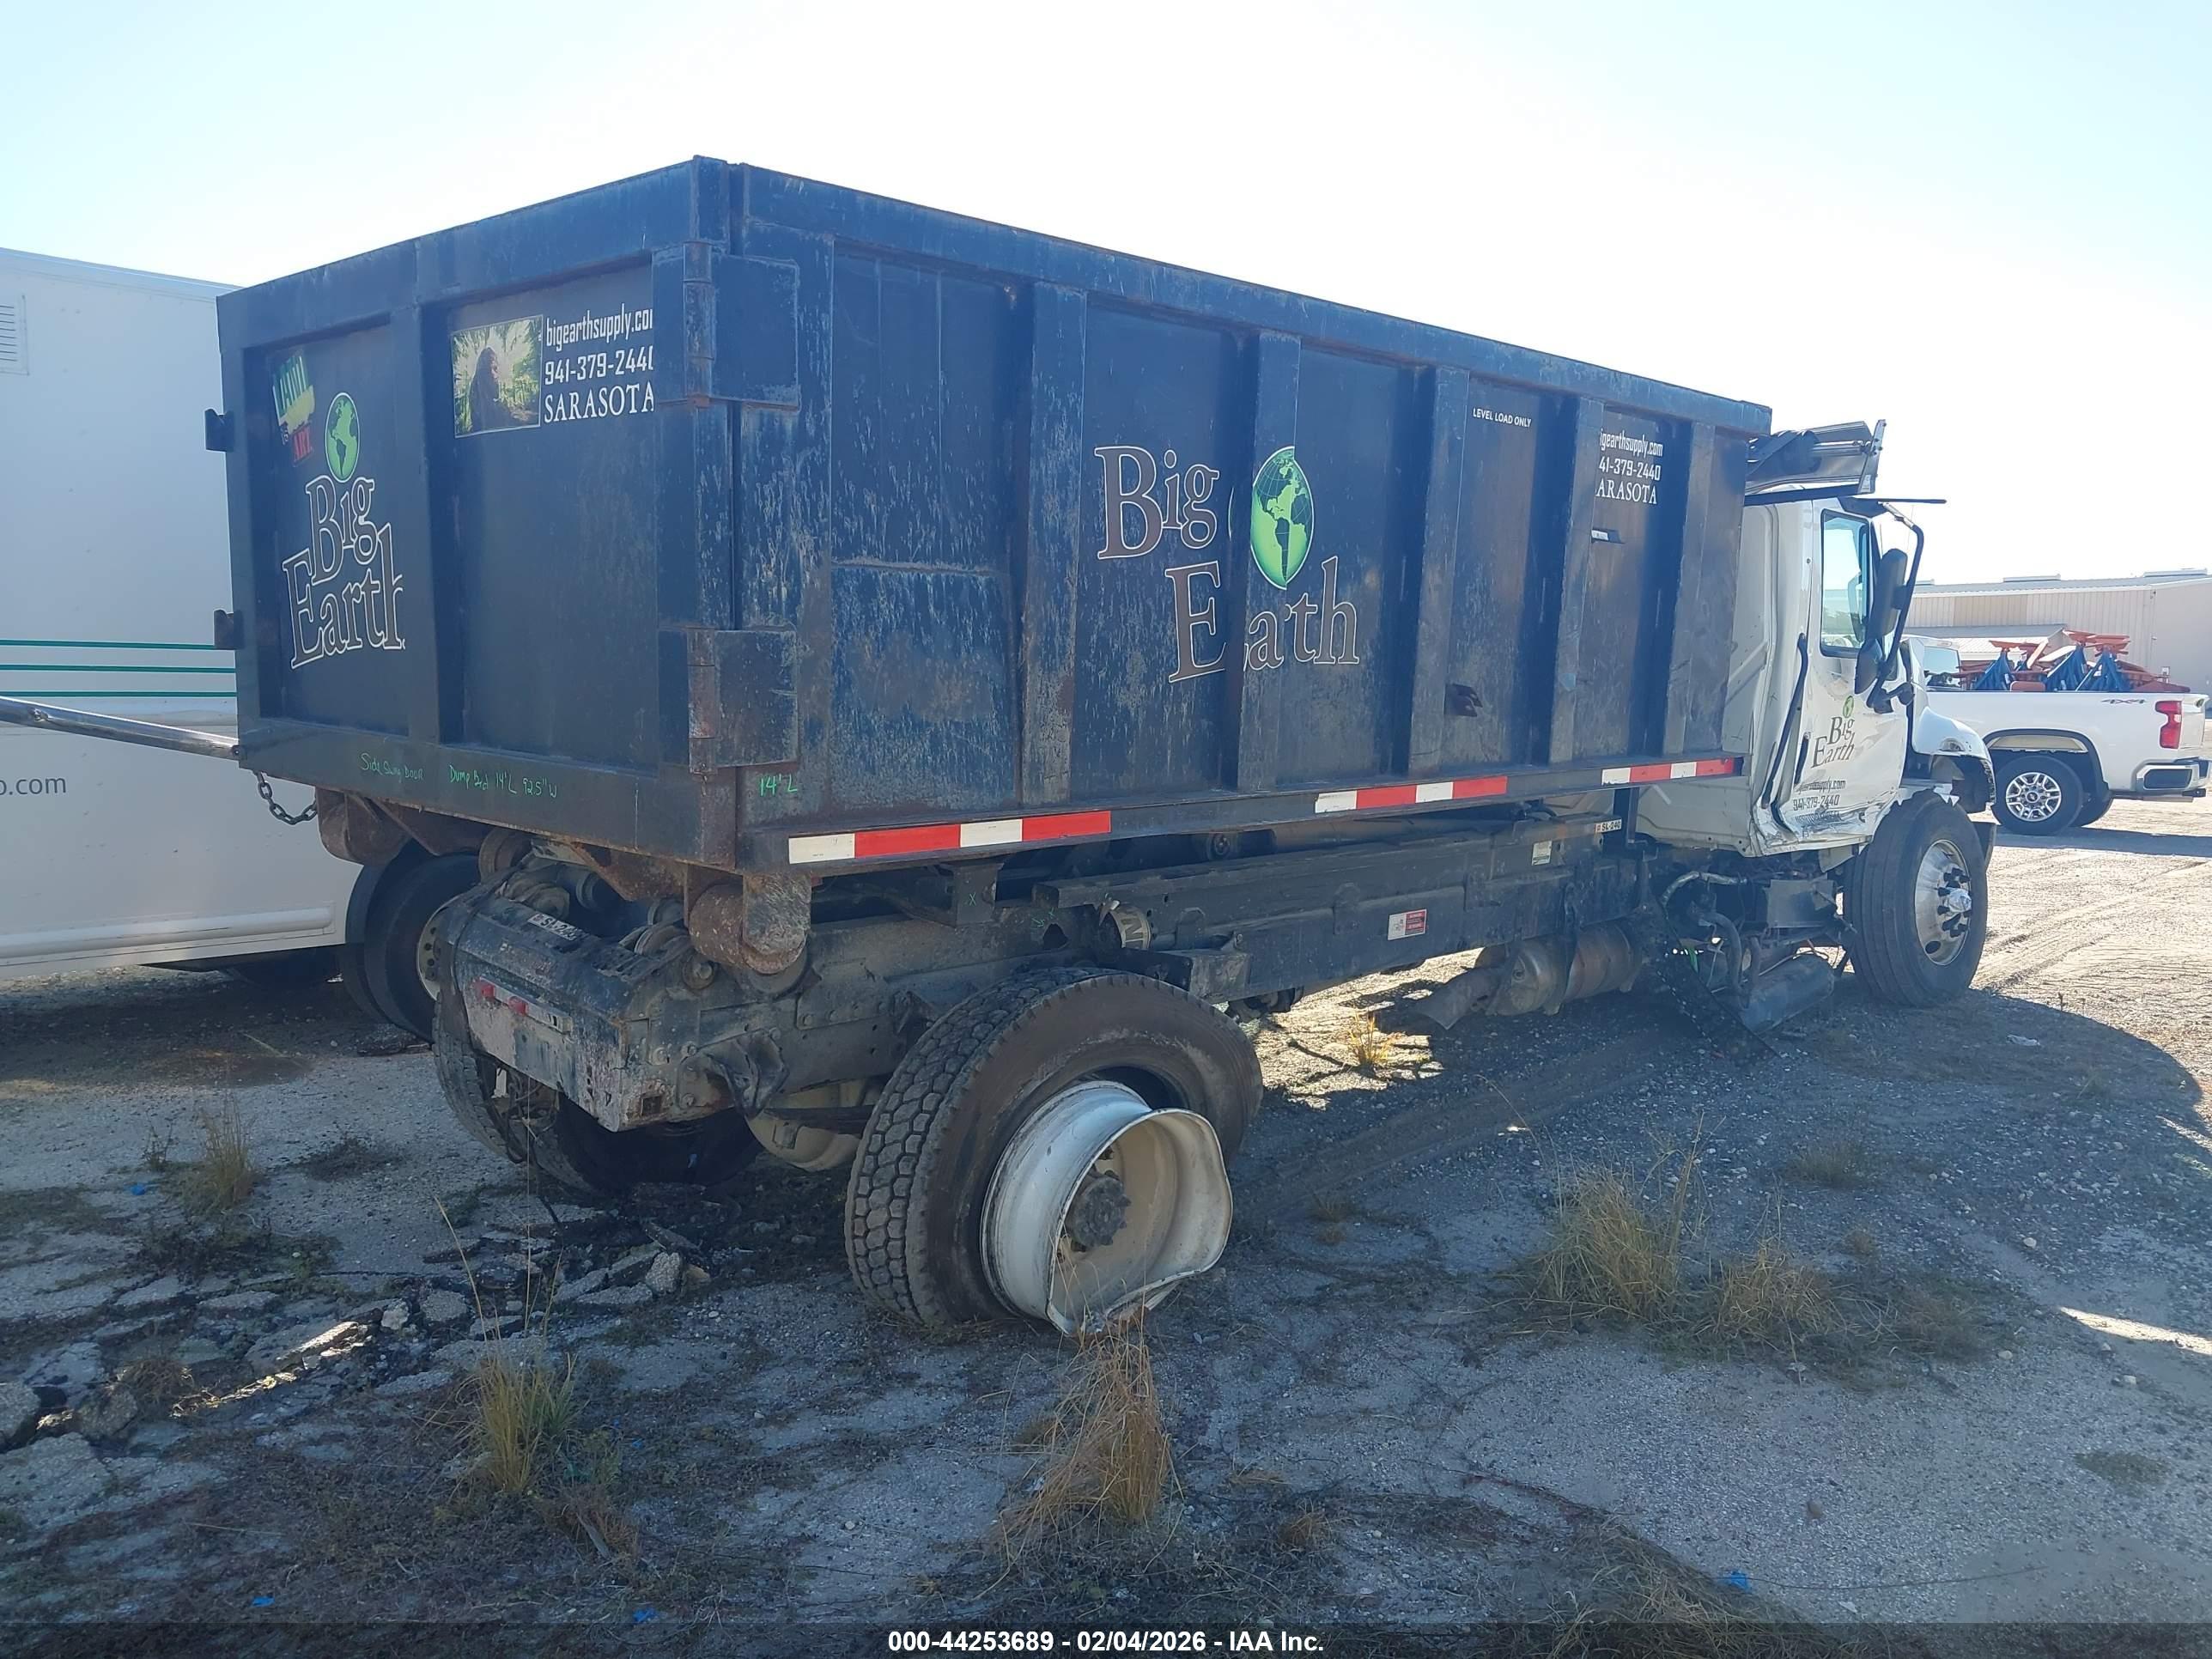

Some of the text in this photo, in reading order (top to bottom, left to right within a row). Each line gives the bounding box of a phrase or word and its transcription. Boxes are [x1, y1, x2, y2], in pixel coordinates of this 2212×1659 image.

[544, 380, 654, 423] SARASOTA
[1473, 407, 1532, 428] LEVEL LOAD ONLY
[1600, 427, 1663, 459] igearthsupply.com
[1598, 455, 1662, 481] 41-379-2440
[1094, 446, 1220, 560] Big
[1595, 477, 1657, 505] ARASOTA
[305, 475, 378, 586] Big
[1164, 555, 1360, 684] Eath
[1826, 716, 1856, 745] Big
[1810, 732, 1856, 769] Earth
[449, 763, 471, 790] Dump
